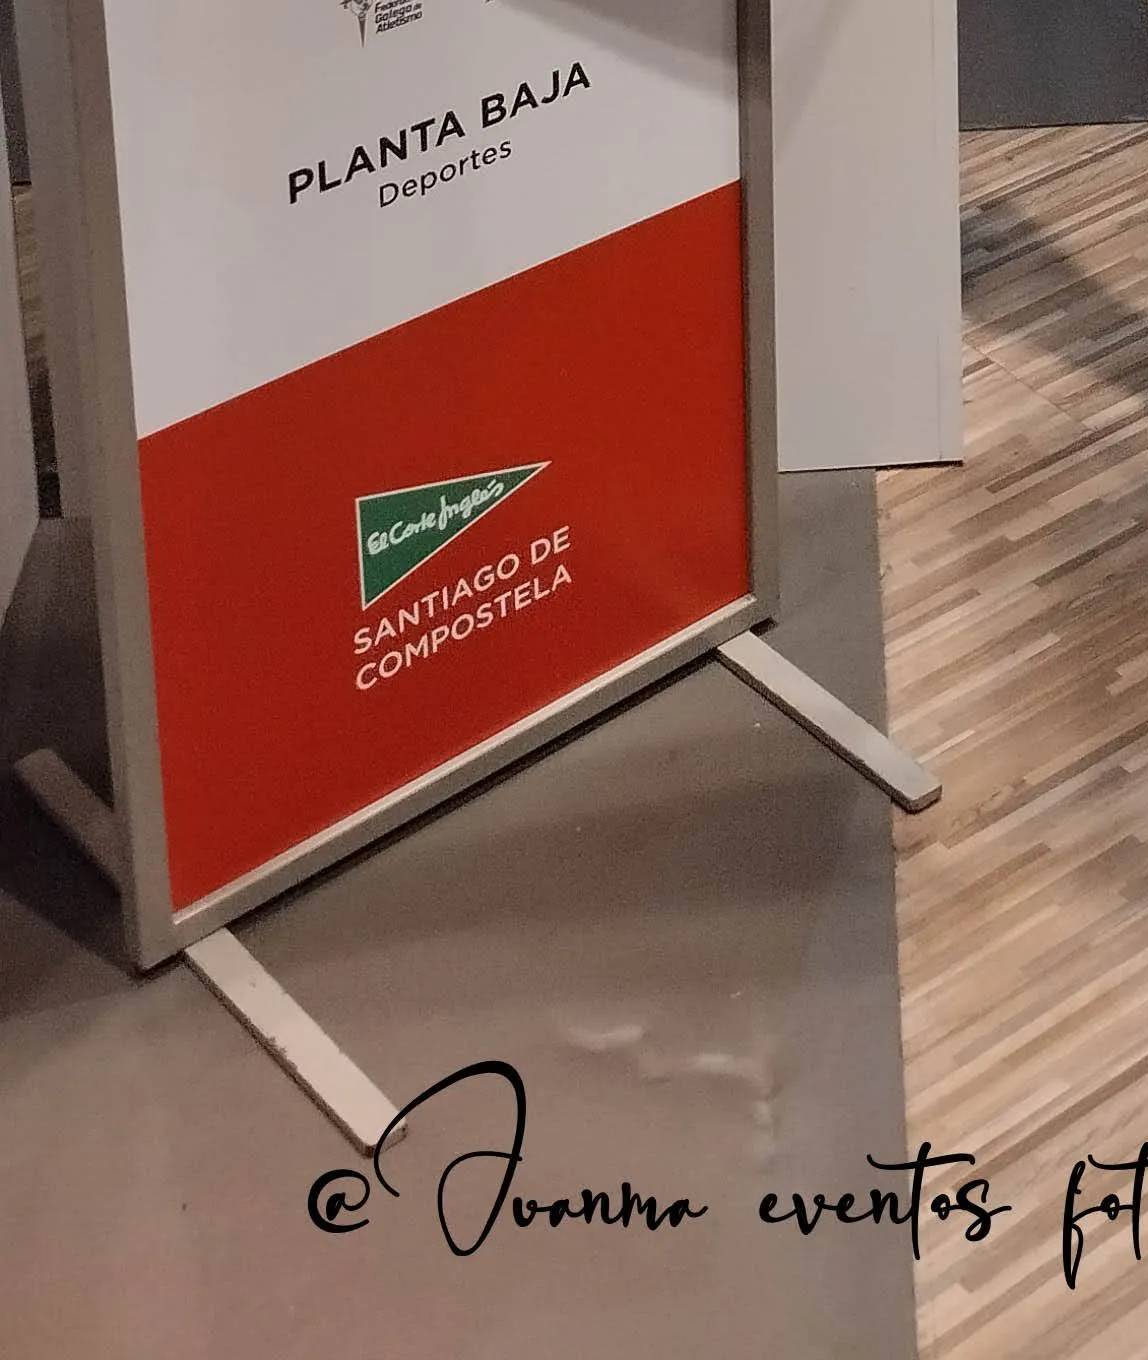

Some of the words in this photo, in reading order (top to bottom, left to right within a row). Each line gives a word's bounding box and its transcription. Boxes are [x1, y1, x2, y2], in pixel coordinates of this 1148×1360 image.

[289, 110, 465, 203] PLANTA
[480, 62, 590, 129] BAJA
[378, 137, 513, 208] Deportes
[367, 530, 389, 555] El
[389, 511, 436, 546] Corte
[438, 479, 505, 530] Inglés
[354, 553, 519, 654] SANTIAGO
[530, 526, 571, 565] DE
[356, 564, 572, 690] COMPOSTELA
